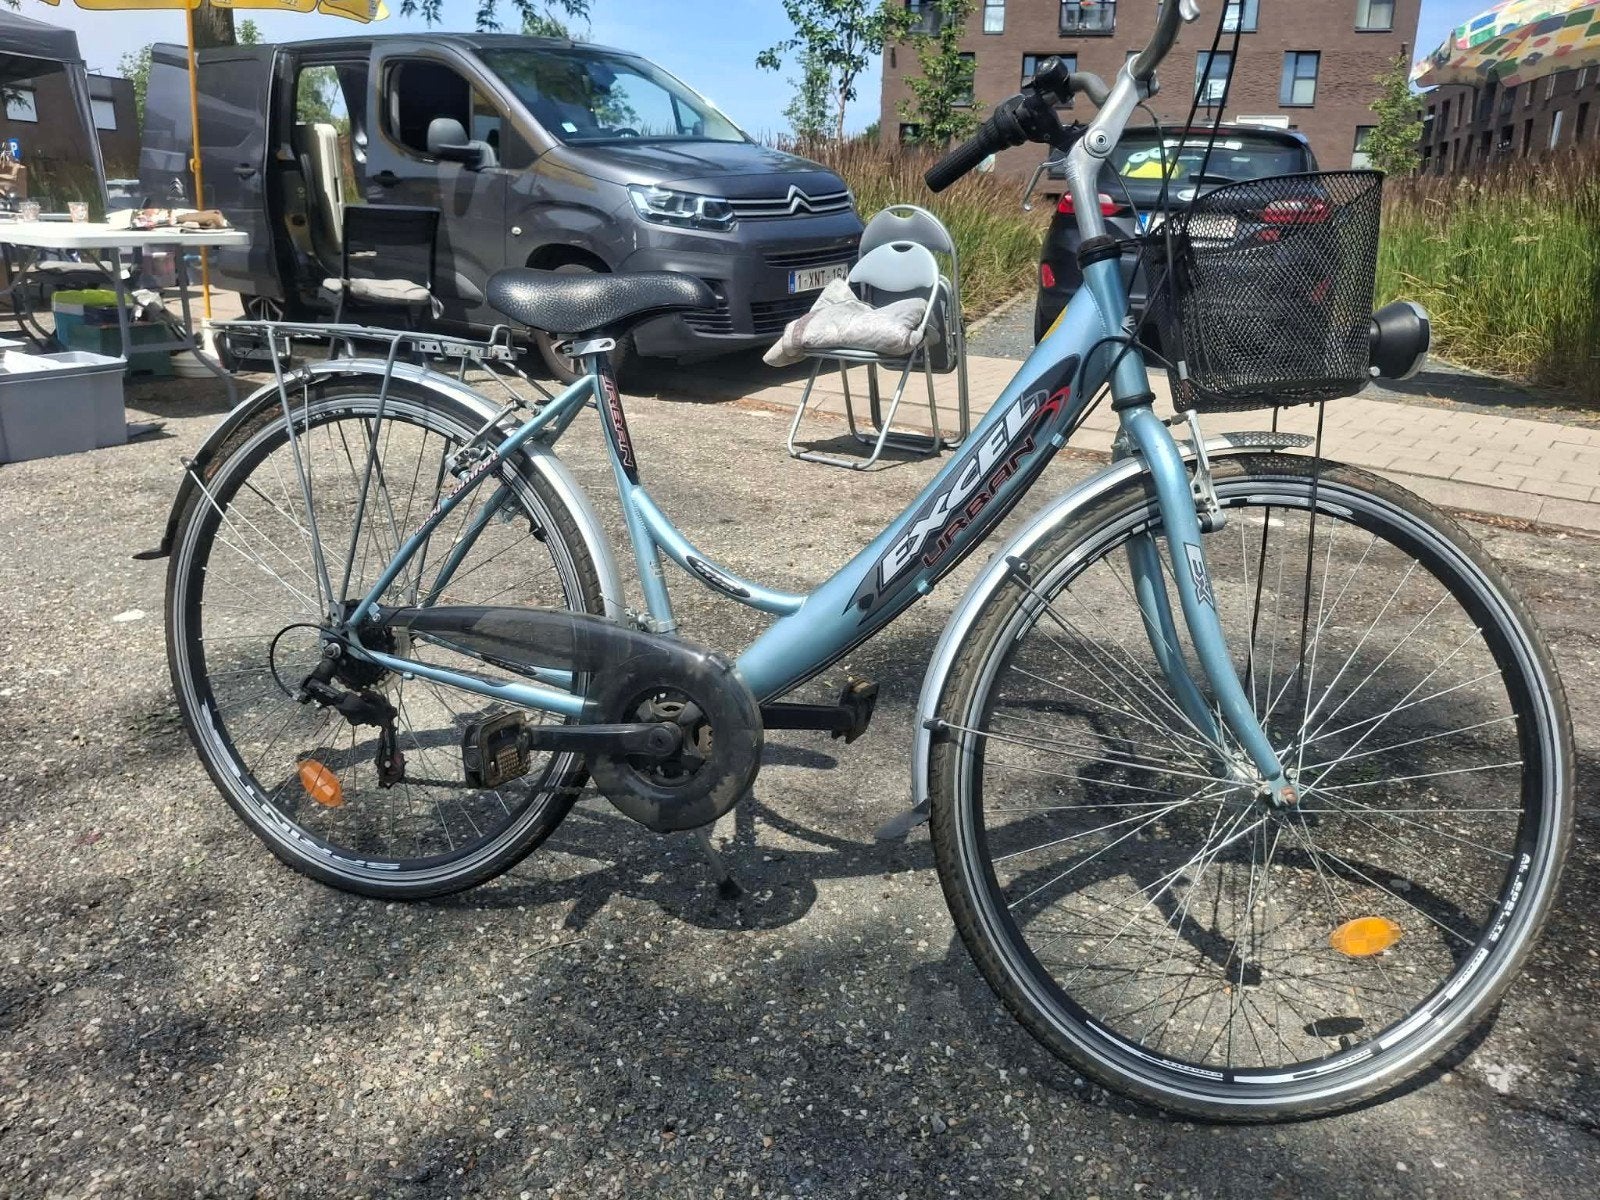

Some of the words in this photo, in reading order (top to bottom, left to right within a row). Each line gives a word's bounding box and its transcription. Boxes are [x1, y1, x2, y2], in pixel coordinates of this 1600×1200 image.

[10, 141, 18, 157] P
[877, 389, 1049, 590] EXCEL
[921, 435, 1037, 569] URBAN
